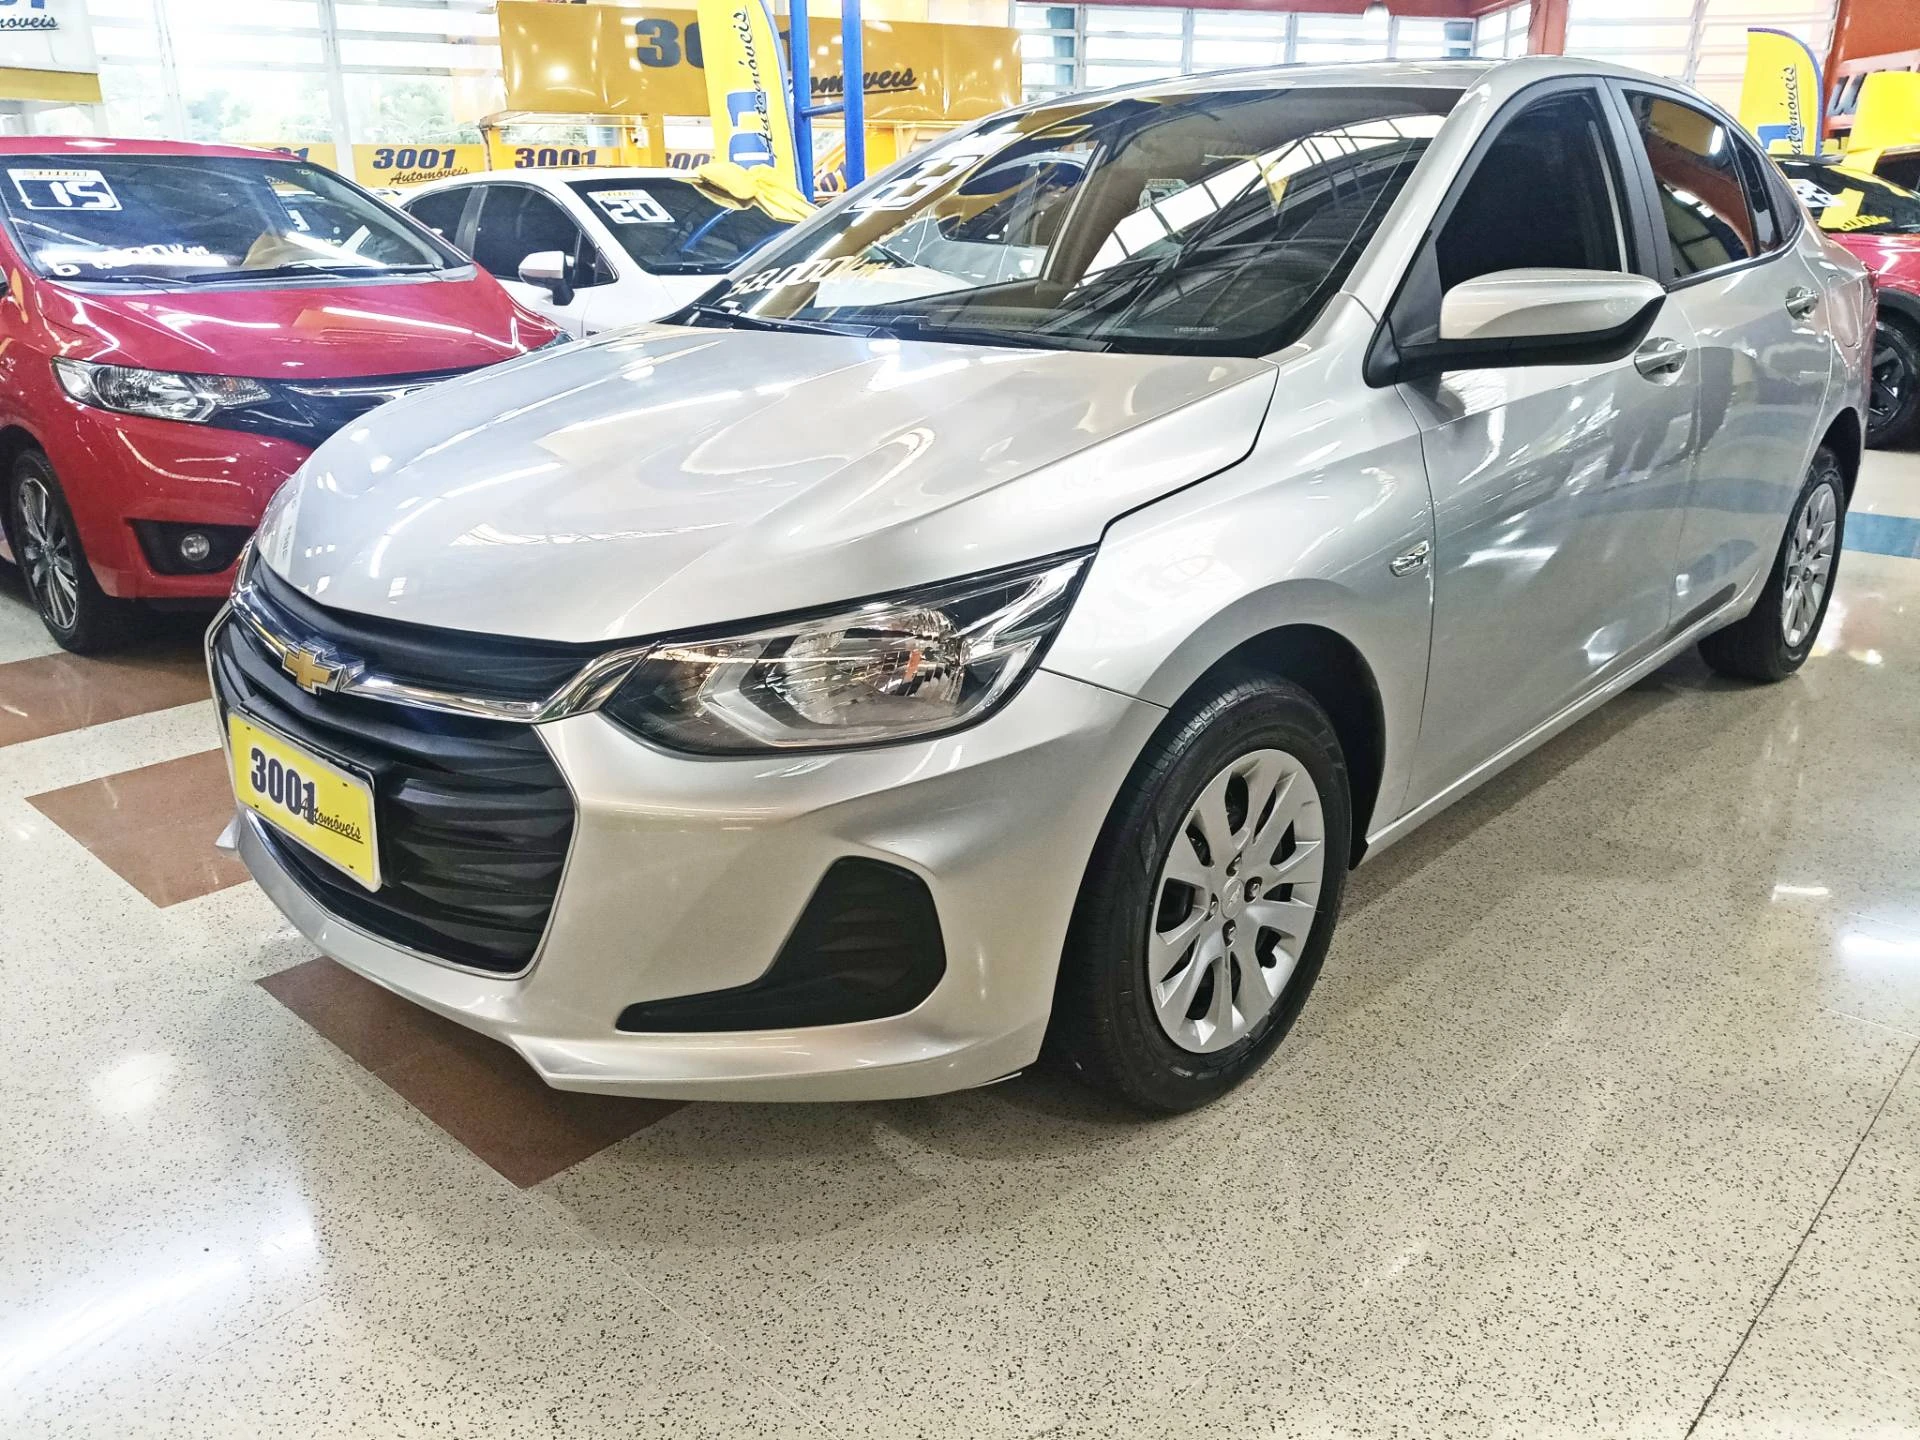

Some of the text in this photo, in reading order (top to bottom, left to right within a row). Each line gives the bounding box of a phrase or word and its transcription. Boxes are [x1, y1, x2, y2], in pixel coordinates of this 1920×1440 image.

[733, 5, 777, 158] Automóveis
[1780, 63, 1804, 156] utomóveis
[372, 148, 456, 169] 3001
[388, 165, 470, 186] Automóveis
[49, 181, 115, 208] 15
[601, 199, 670, 221] 20
[251, 747, 315, 826] 3001
[301, 798, 364, 844] Atomóveis
